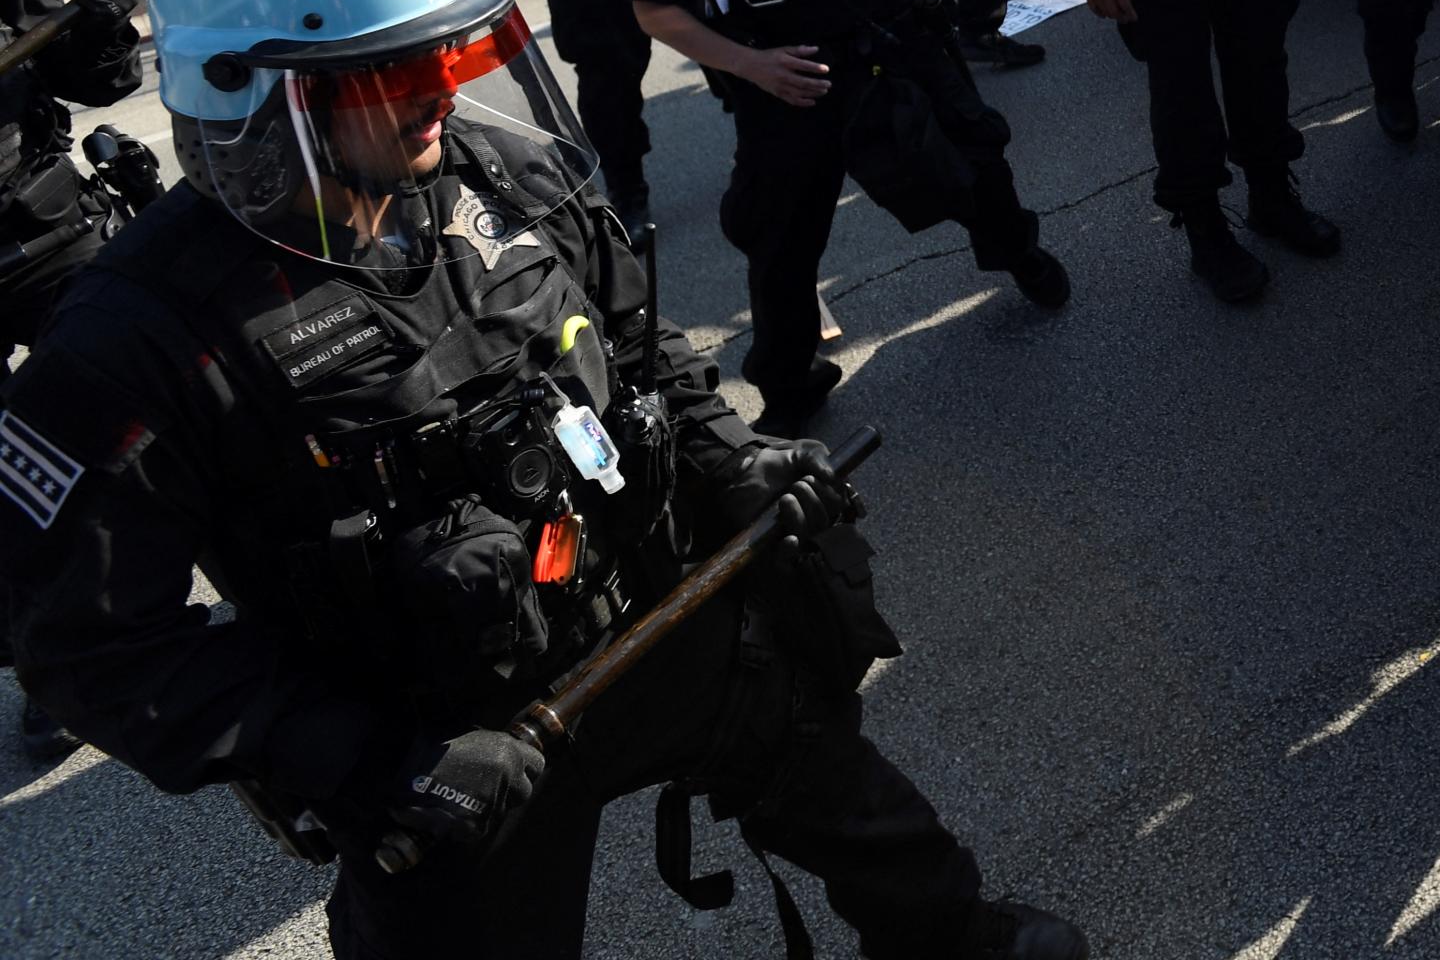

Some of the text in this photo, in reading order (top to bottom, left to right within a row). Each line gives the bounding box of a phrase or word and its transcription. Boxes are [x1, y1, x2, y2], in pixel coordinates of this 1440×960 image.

[463, 203, 478, 240] CHICAGO
[290, 306, 356, 345] ALVAREZ
[290, 326, 382, 377] BUREAU OF PATROL
